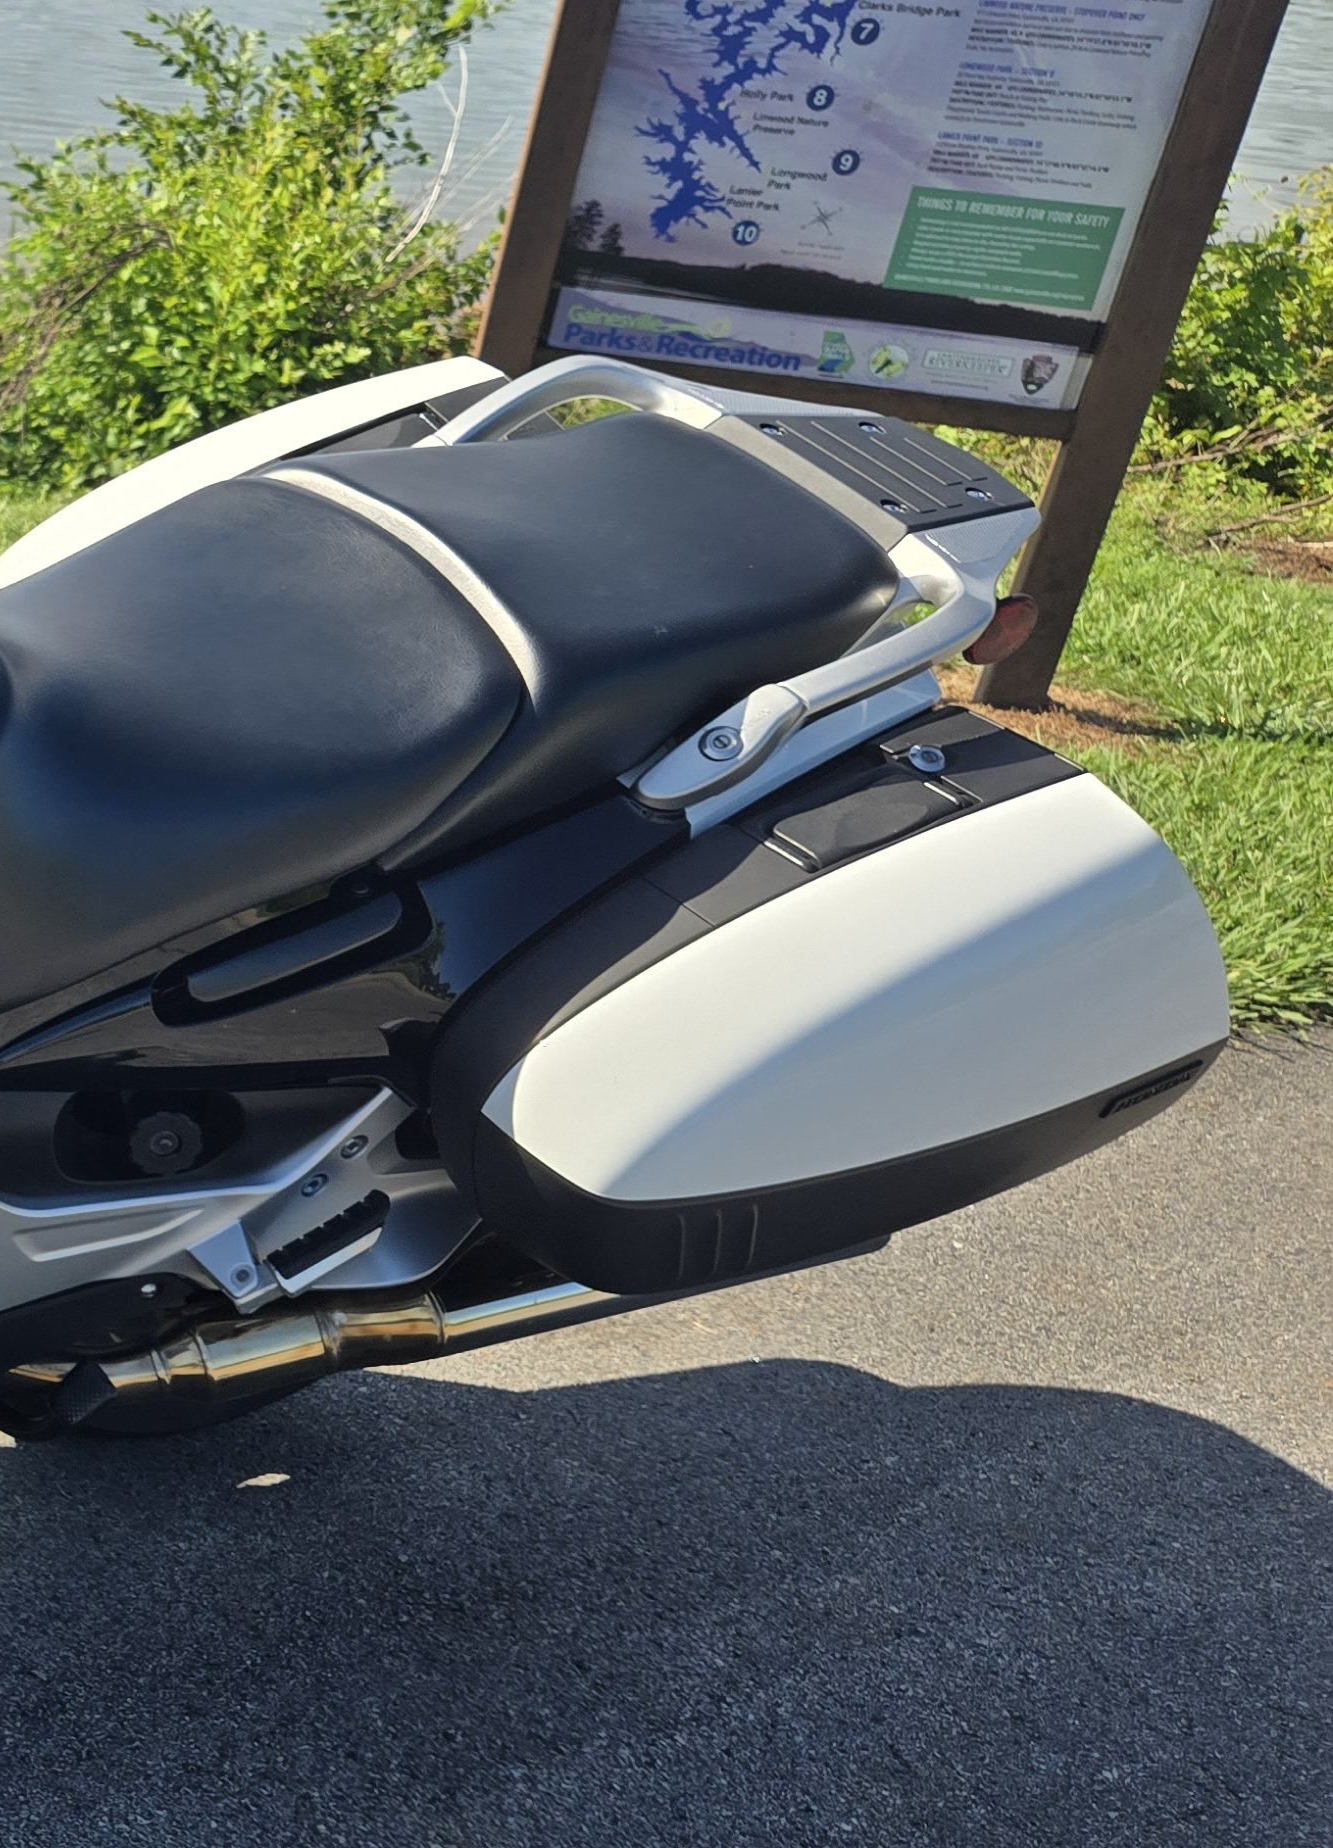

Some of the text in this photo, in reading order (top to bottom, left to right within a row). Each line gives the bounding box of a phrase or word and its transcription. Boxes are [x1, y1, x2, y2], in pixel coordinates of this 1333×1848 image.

[858, 23, 874, 41] 7
[770, 89, 794, 101] Park
[813, 89, 828, 107] 8
[839, 153, 853, 171] 9
[767, 179, 791, 191] Park
[917, 196, 953, 212] THINGS
[955, 199, 968, 213] TO
[969, 201, 1025, 220] REMEMBER
[1026, 207, 1044, 221] FOR
[1046, 209, 1074, 225] YOUR
[1074, 212, 1111, 229] SAFETY
[735, 225, 758, 243] 10
